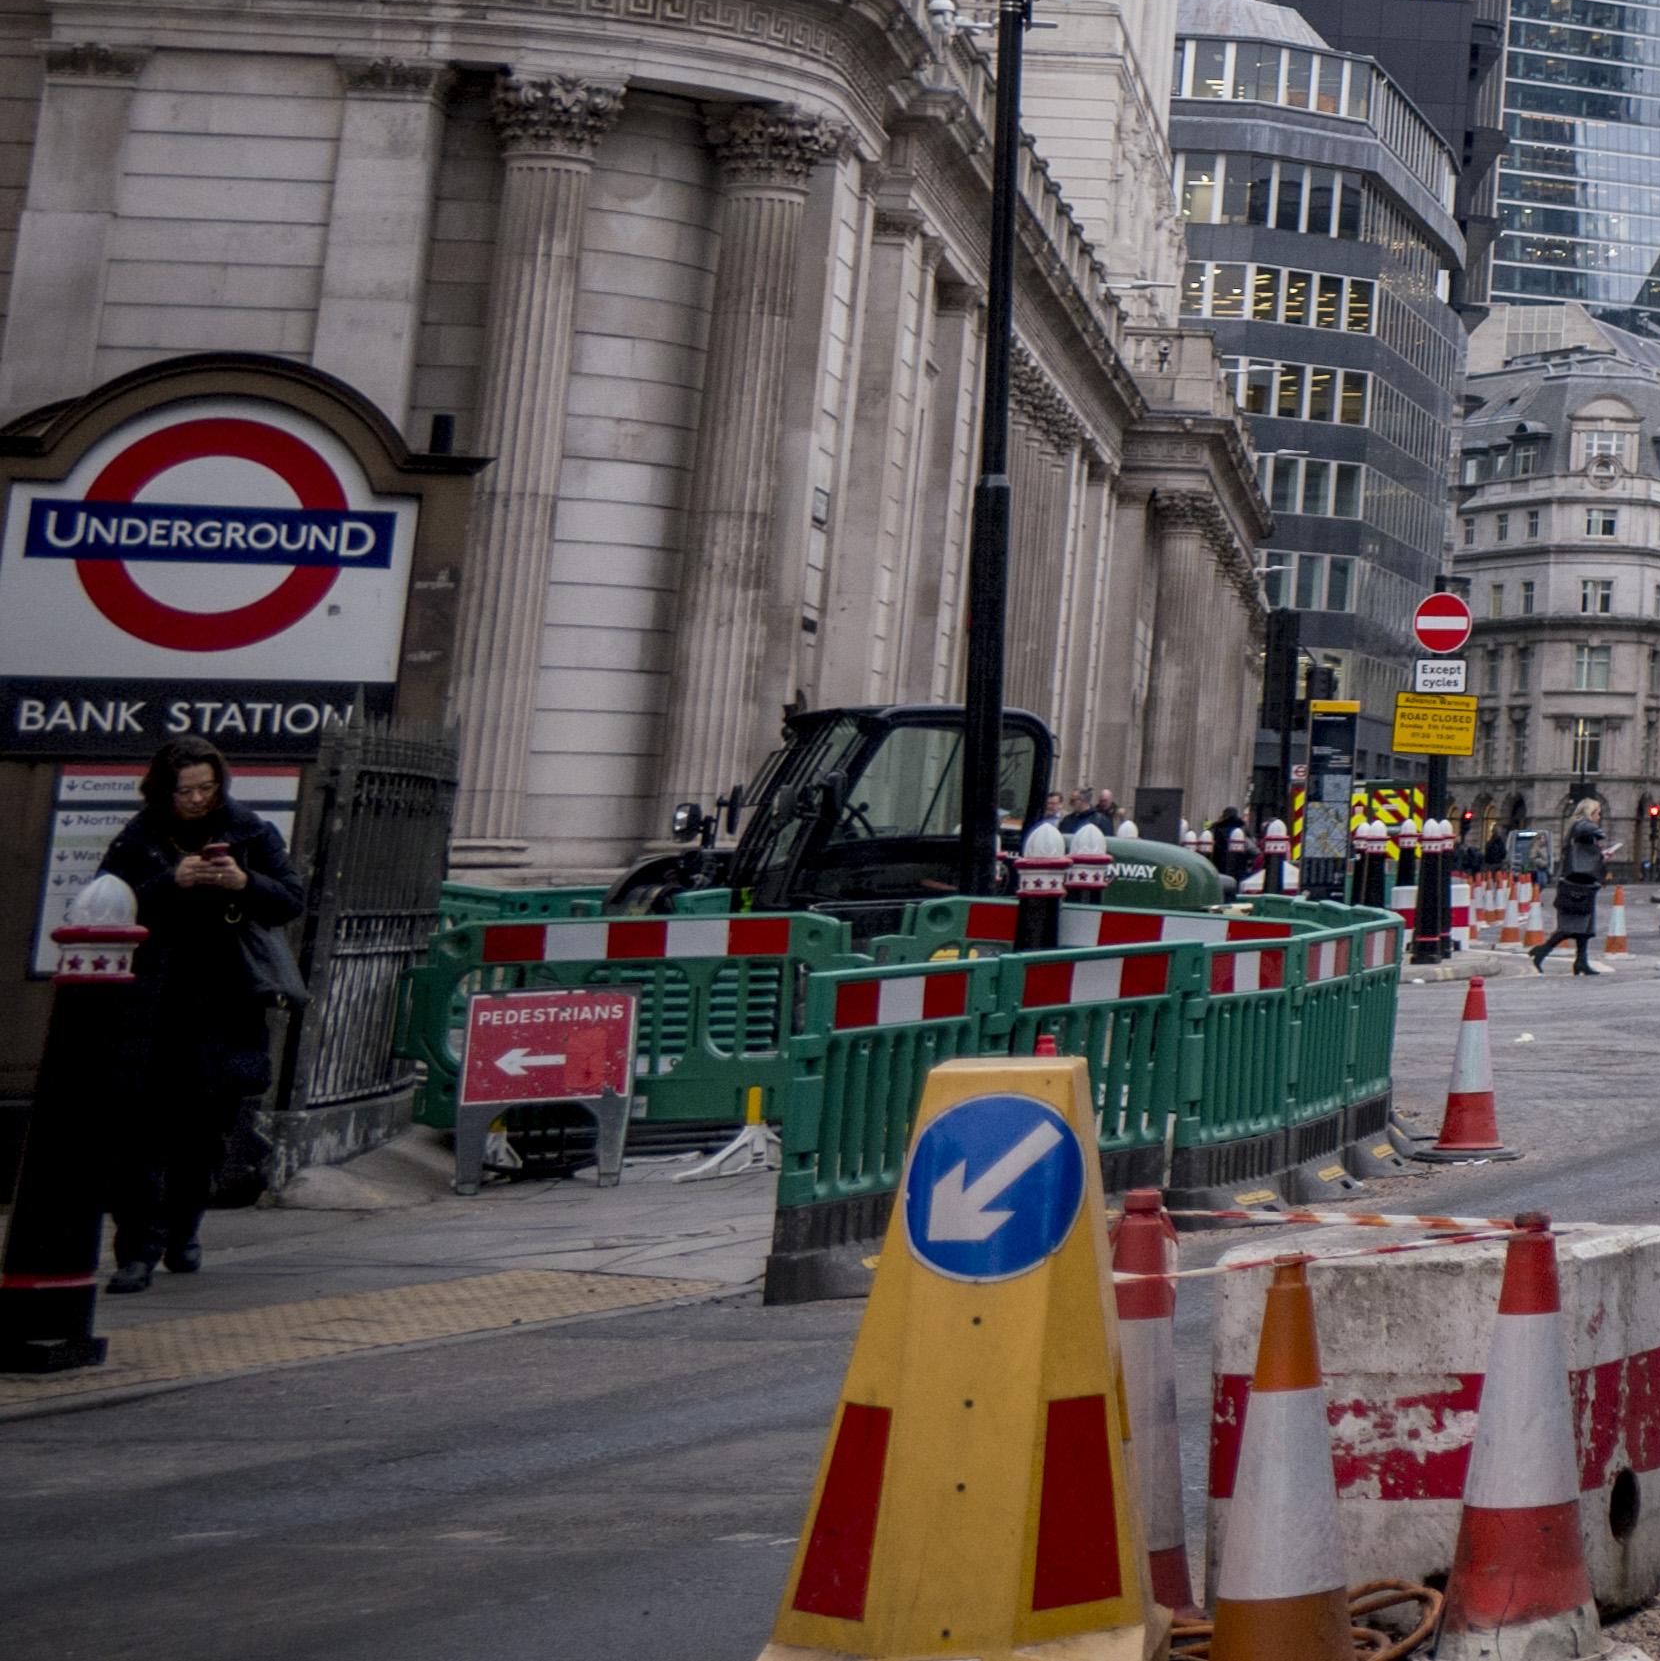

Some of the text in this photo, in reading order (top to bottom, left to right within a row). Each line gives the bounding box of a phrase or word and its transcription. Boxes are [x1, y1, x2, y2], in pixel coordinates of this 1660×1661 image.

[45, 510, 375, 558] UNDERGROUND
[1421, 665, 1462, 676] Except
[1422, 677, 1459, 688] cycles
[18, 700, 354, 734] BANK STATION
[1400, 713, 1472, 723] ROAD CLOSED
[81, 780, 135, 792] Central
[478, 1004, 623, 1026] PEDESTRIANS
